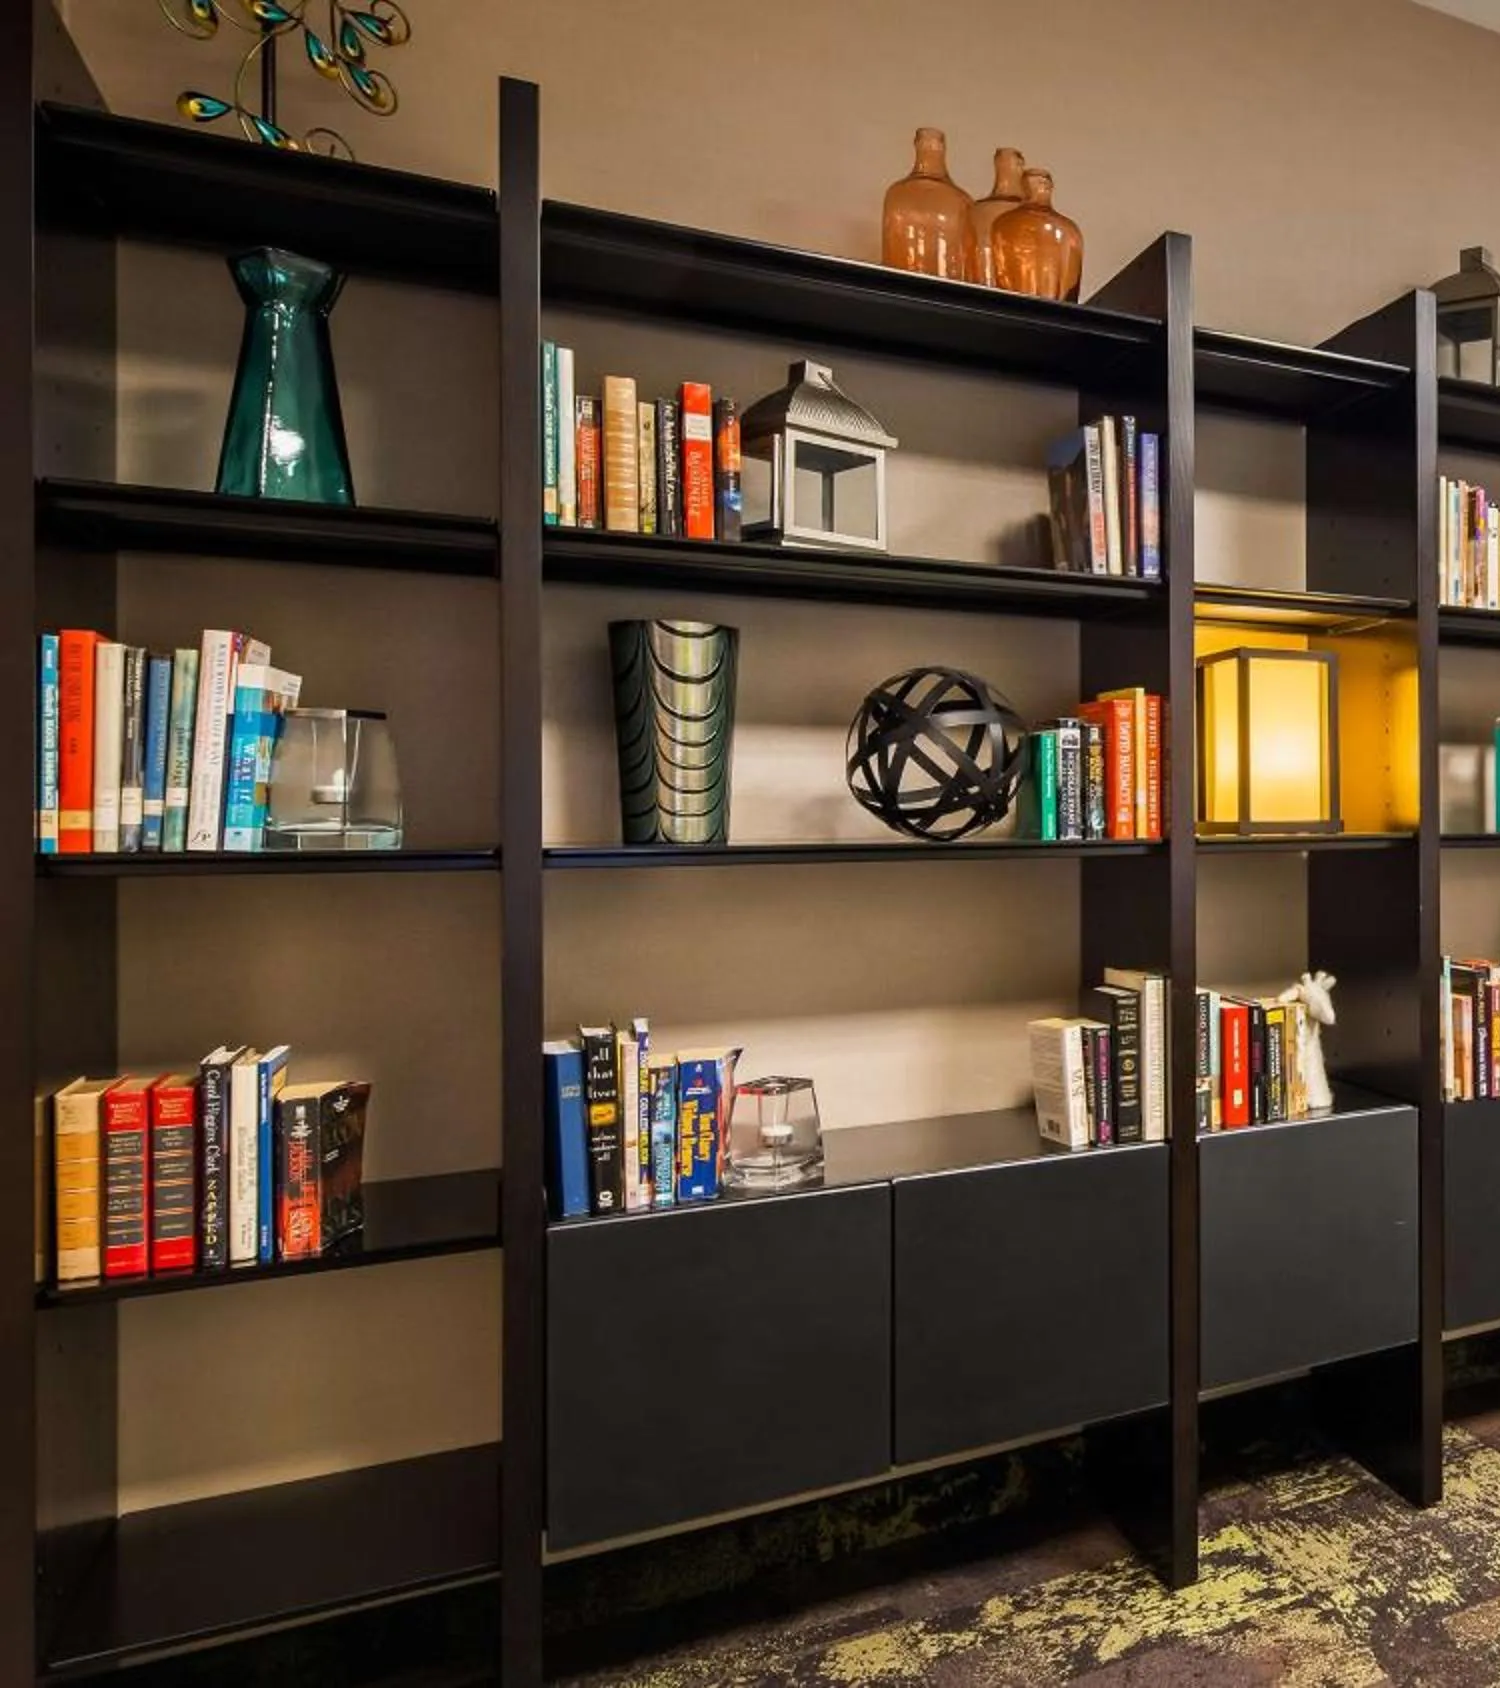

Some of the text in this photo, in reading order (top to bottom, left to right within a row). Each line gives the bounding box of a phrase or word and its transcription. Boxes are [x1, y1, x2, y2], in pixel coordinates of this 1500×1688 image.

[241, 743, 256, 782] What
[587, 1068, 613, 1080] that
[591, 1048, 609, 1062] all
[203, 1068, 222, 1174] Carol Higgins Clark
[205, 1179, 217, 1245] ZAPPED
